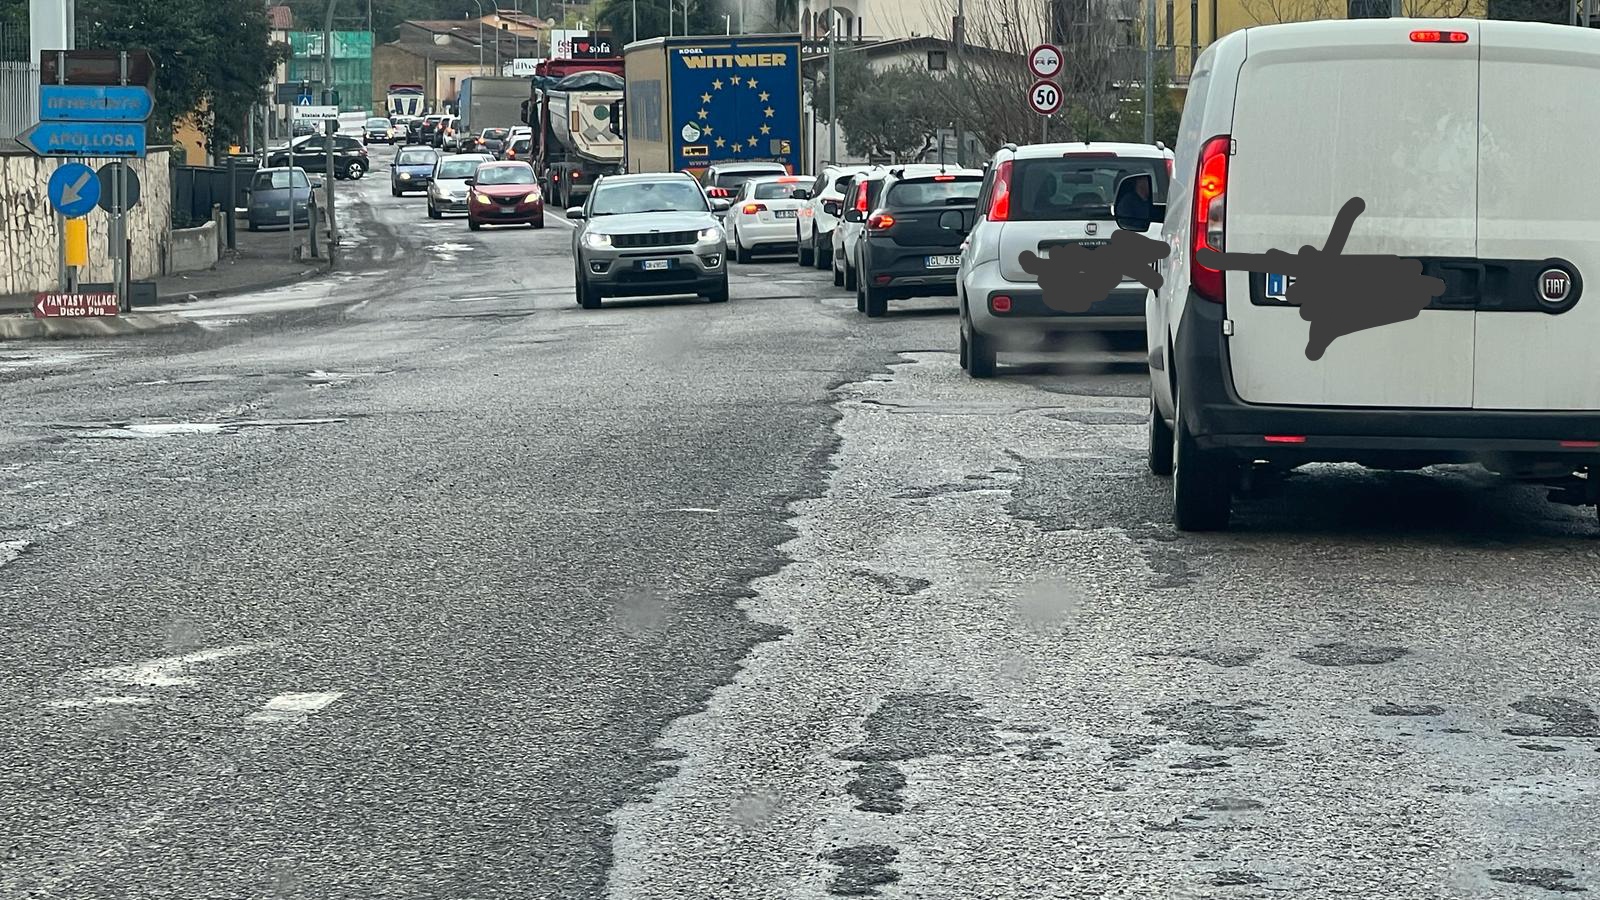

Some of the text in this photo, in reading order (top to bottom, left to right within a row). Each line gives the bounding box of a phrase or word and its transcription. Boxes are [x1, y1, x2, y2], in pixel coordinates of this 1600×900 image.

[682, 53, 787, 69] WITTWER
[1036, 89, 1056, 105] 50
[48, 132, 135, 147] APOLLOSA
[1545, 278, 1565, 294] FIAT
[46, 294, 117, 307] FANTASY VILLAGE
